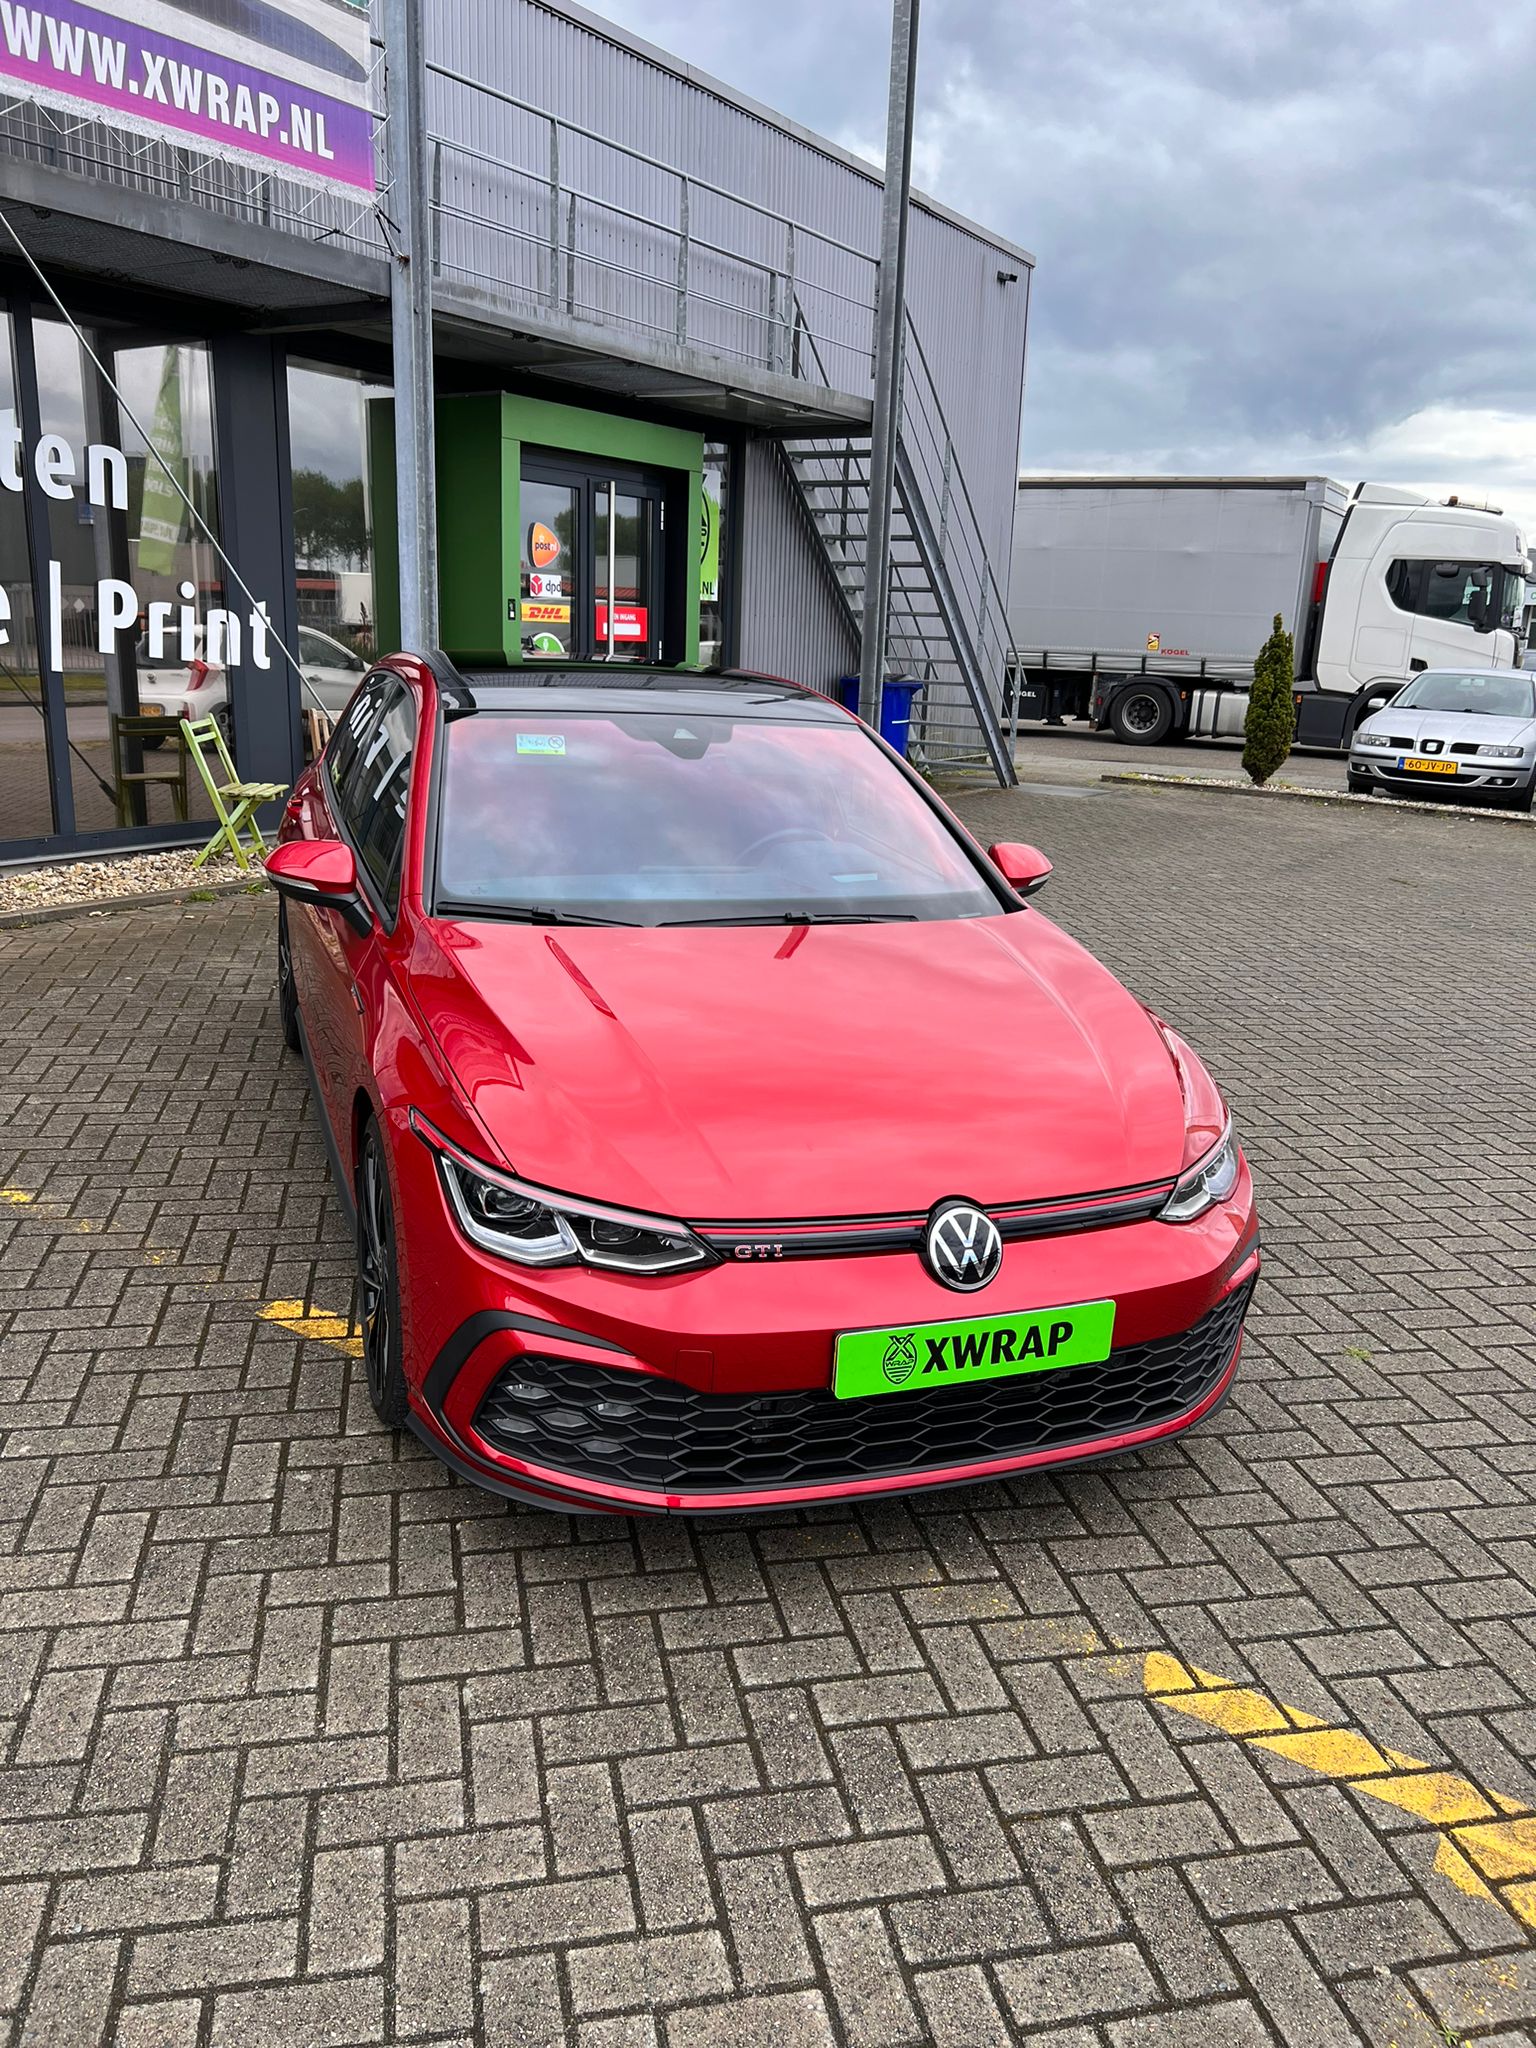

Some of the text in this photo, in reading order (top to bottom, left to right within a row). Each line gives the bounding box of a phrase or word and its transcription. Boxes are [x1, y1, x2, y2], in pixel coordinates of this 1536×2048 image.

[0, 0, 335, 160] WWW.XWRAP.NL
[545, 579, 561, 595] dpd
[97, 578, 272, 670] Print
[529, 606, 563, 620] DHL
[734, 1243, 783, 1259] GTI
[921, 1320, 1074, 1375] XWRAP
